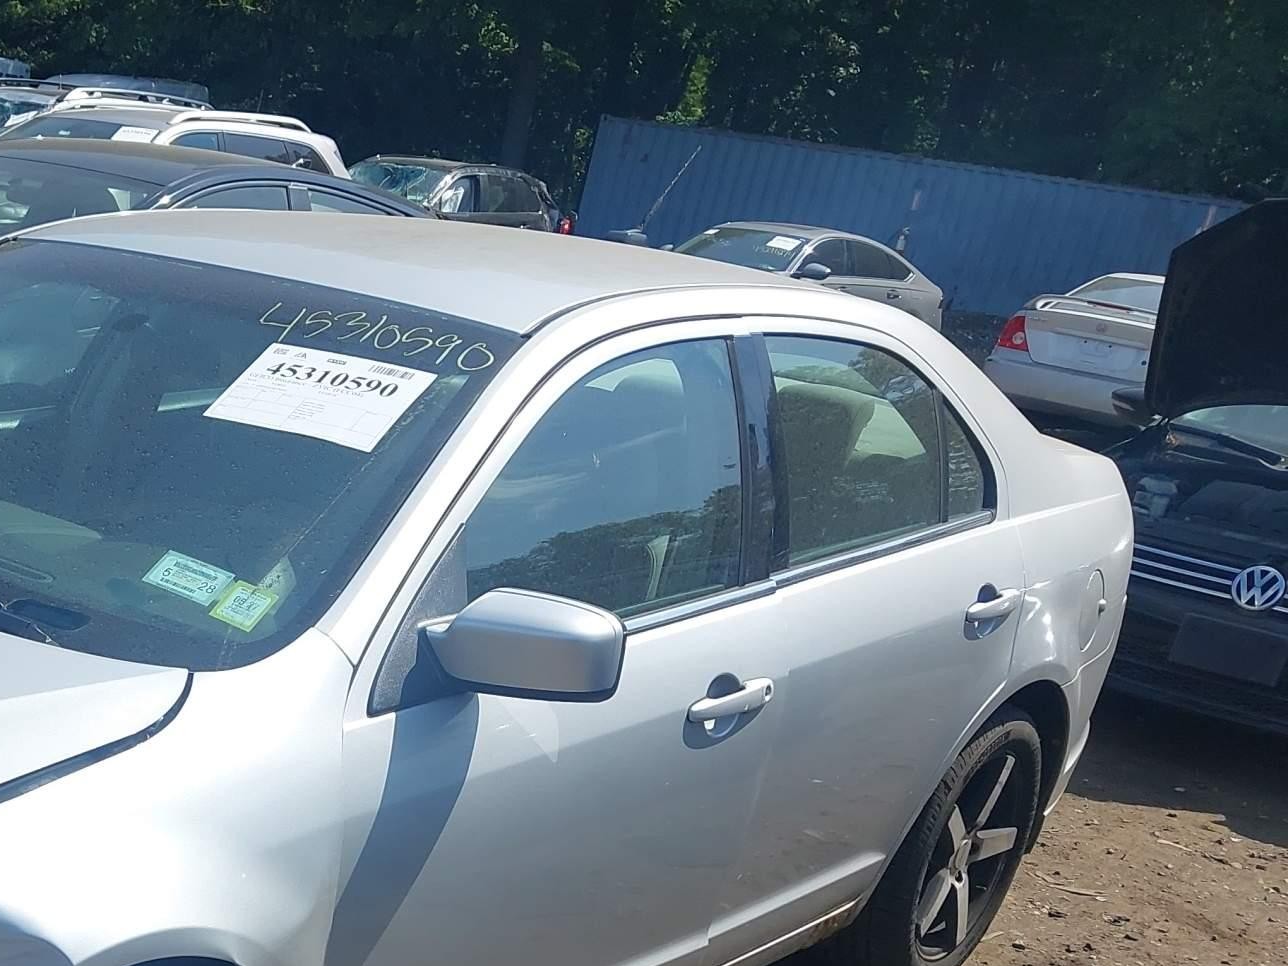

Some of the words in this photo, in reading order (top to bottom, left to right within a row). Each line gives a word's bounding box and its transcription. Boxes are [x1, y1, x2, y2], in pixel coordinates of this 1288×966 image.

[260, 302, 495, 371] 45310590
[266, 362, 399, 397] 45310590
[162, 567, 173, 577] 5
[197, 582, 216, 593] 28
